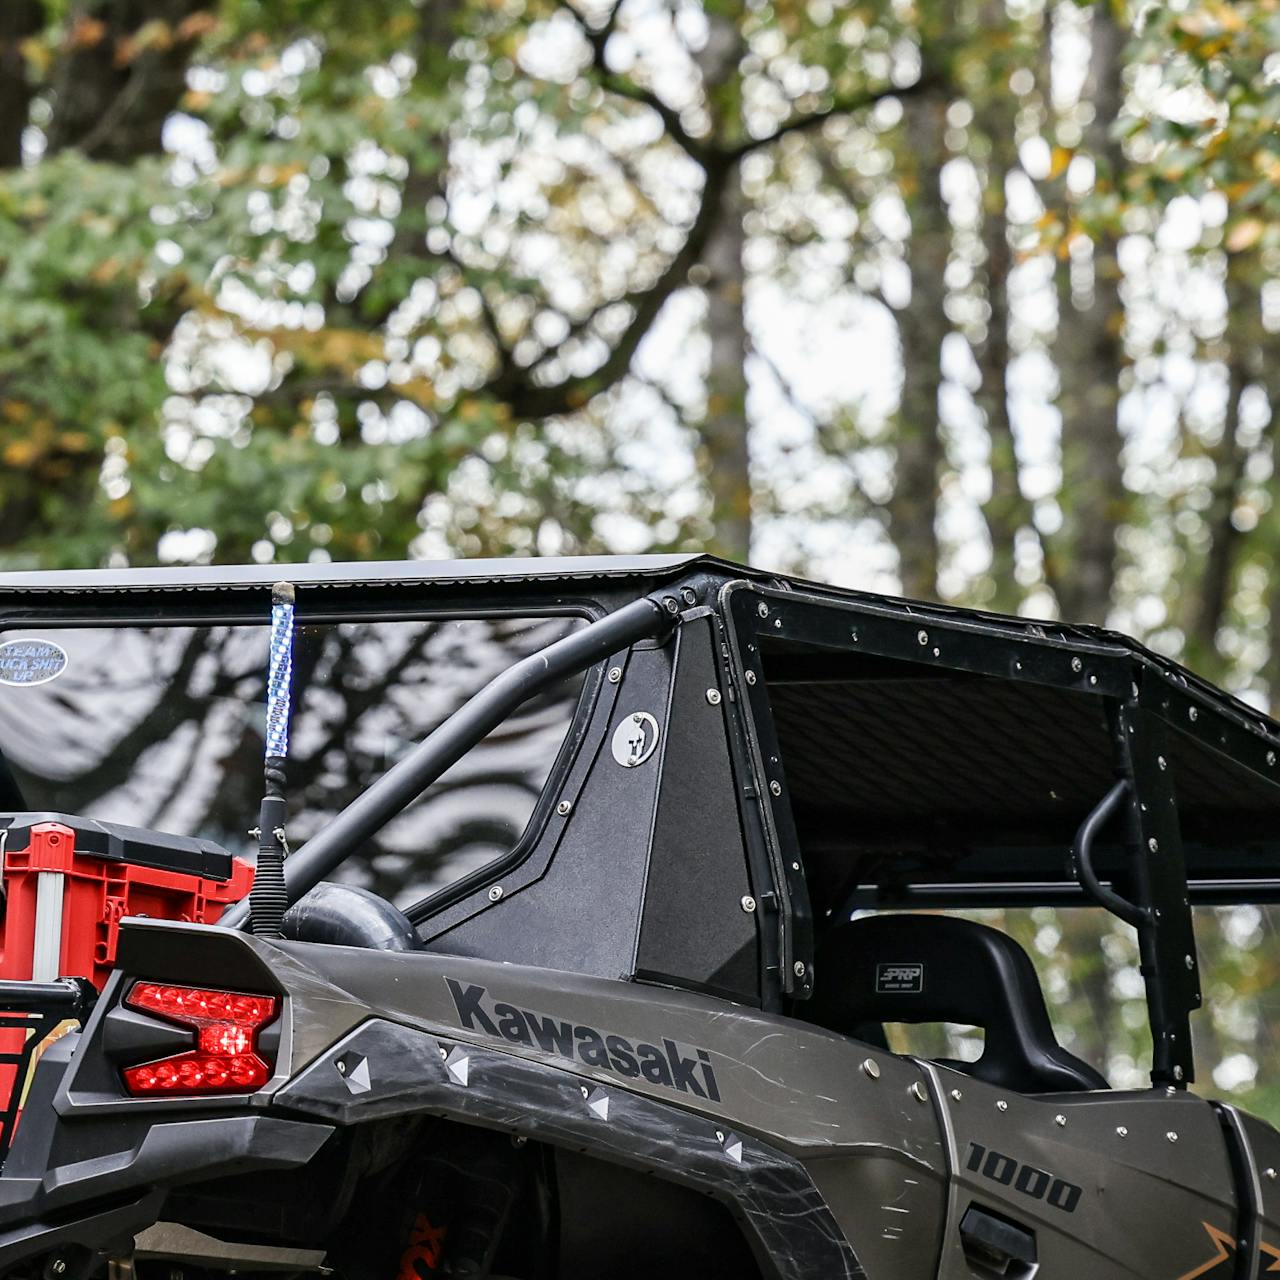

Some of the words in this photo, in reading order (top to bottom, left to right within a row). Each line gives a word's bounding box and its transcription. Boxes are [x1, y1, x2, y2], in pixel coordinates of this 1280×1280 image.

[4, 645, 50, 657] TEAM
[14, 671, 34, 681] UP
[442, 975, 721, 1103] Kawasaki
[964, 1141, 1084, 1213] 1000
